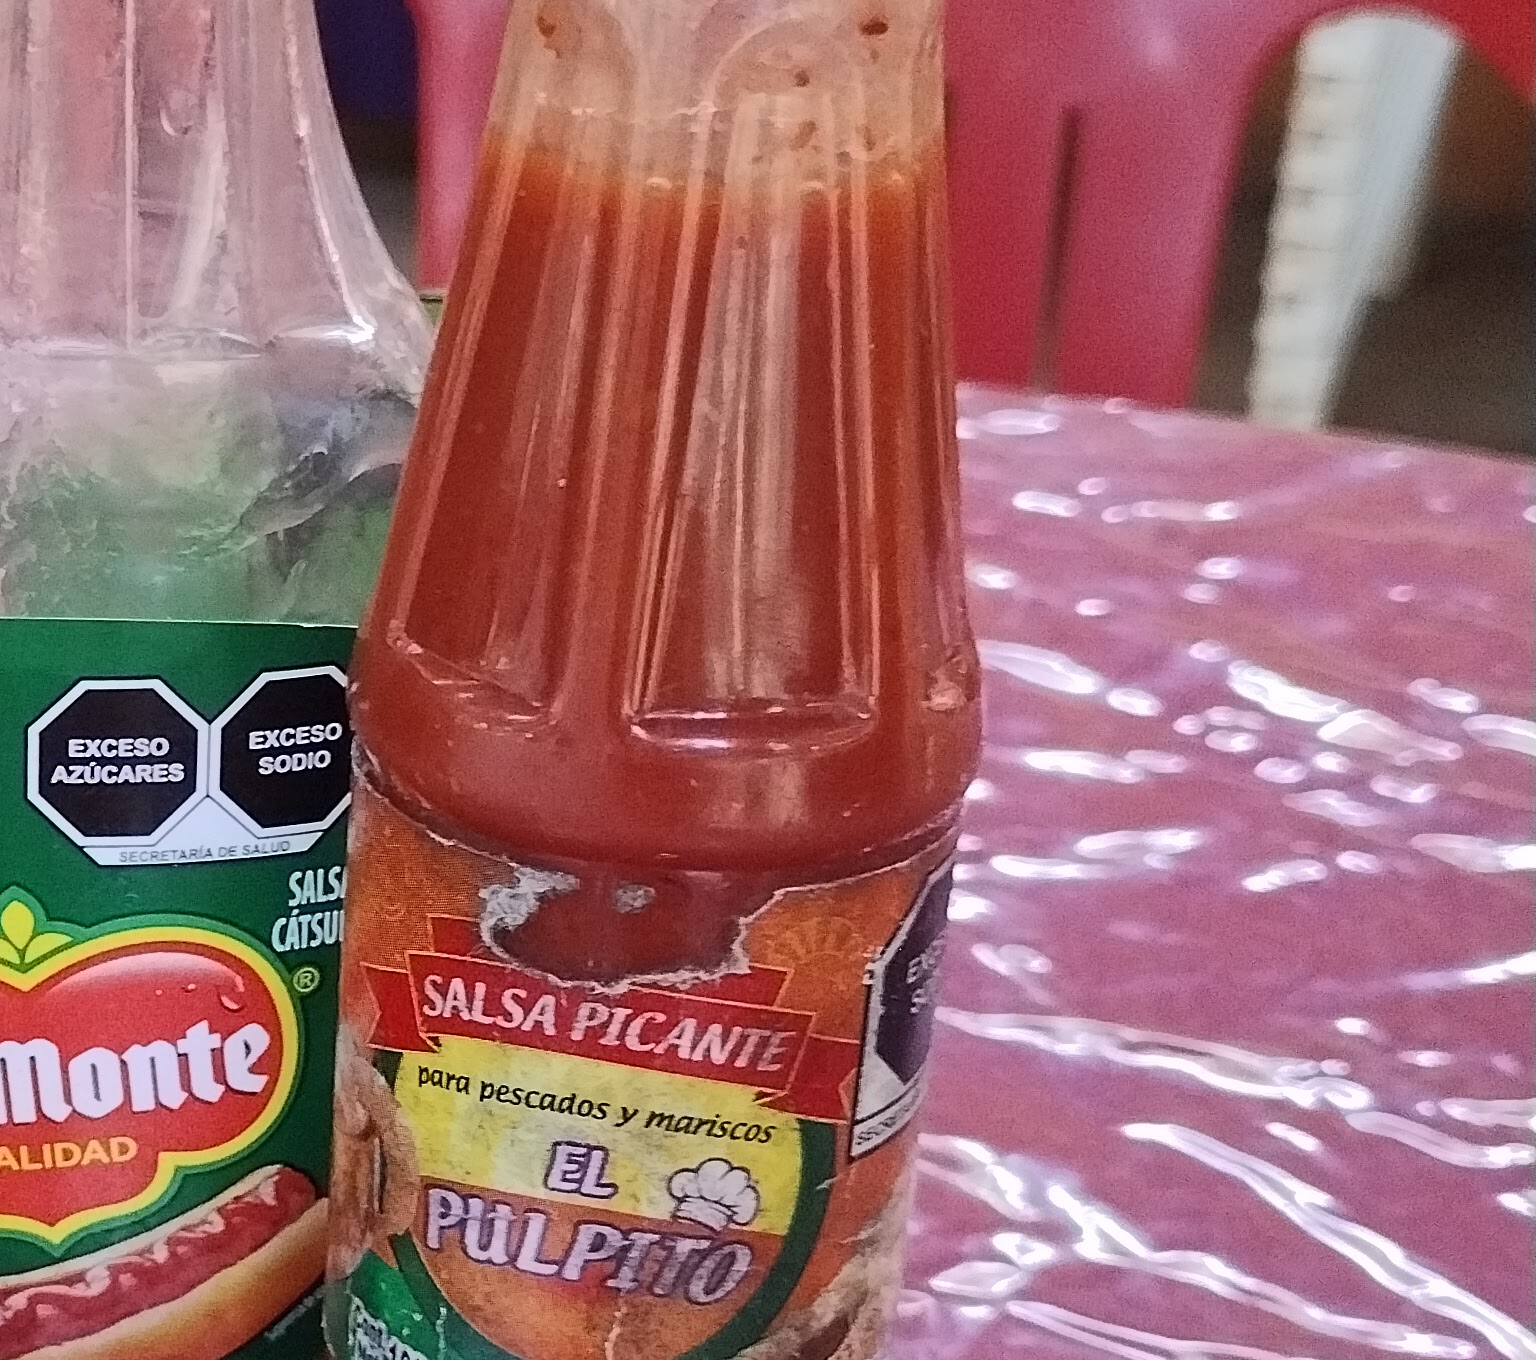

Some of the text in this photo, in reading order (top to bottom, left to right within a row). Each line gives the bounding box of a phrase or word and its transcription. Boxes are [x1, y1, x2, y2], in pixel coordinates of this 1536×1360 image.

[67, 736, 170, 758] EXCESO
[248, 722, 343, 750] EXCESO
[50, 761, 185, 784] AZÚCARES
[258, 750, 332, 775] SODIO
[217, 845, 238, 857] DE
[242, 840, 291, 856] SALUD
[421, 975, 798, 1072] SALSA PICANTE
[417, 1064, 778, 1144] para pescados y mariscos
[546, 1140, 619, 1199] EL
[424, 1185, 752, 1305] PULPITO
